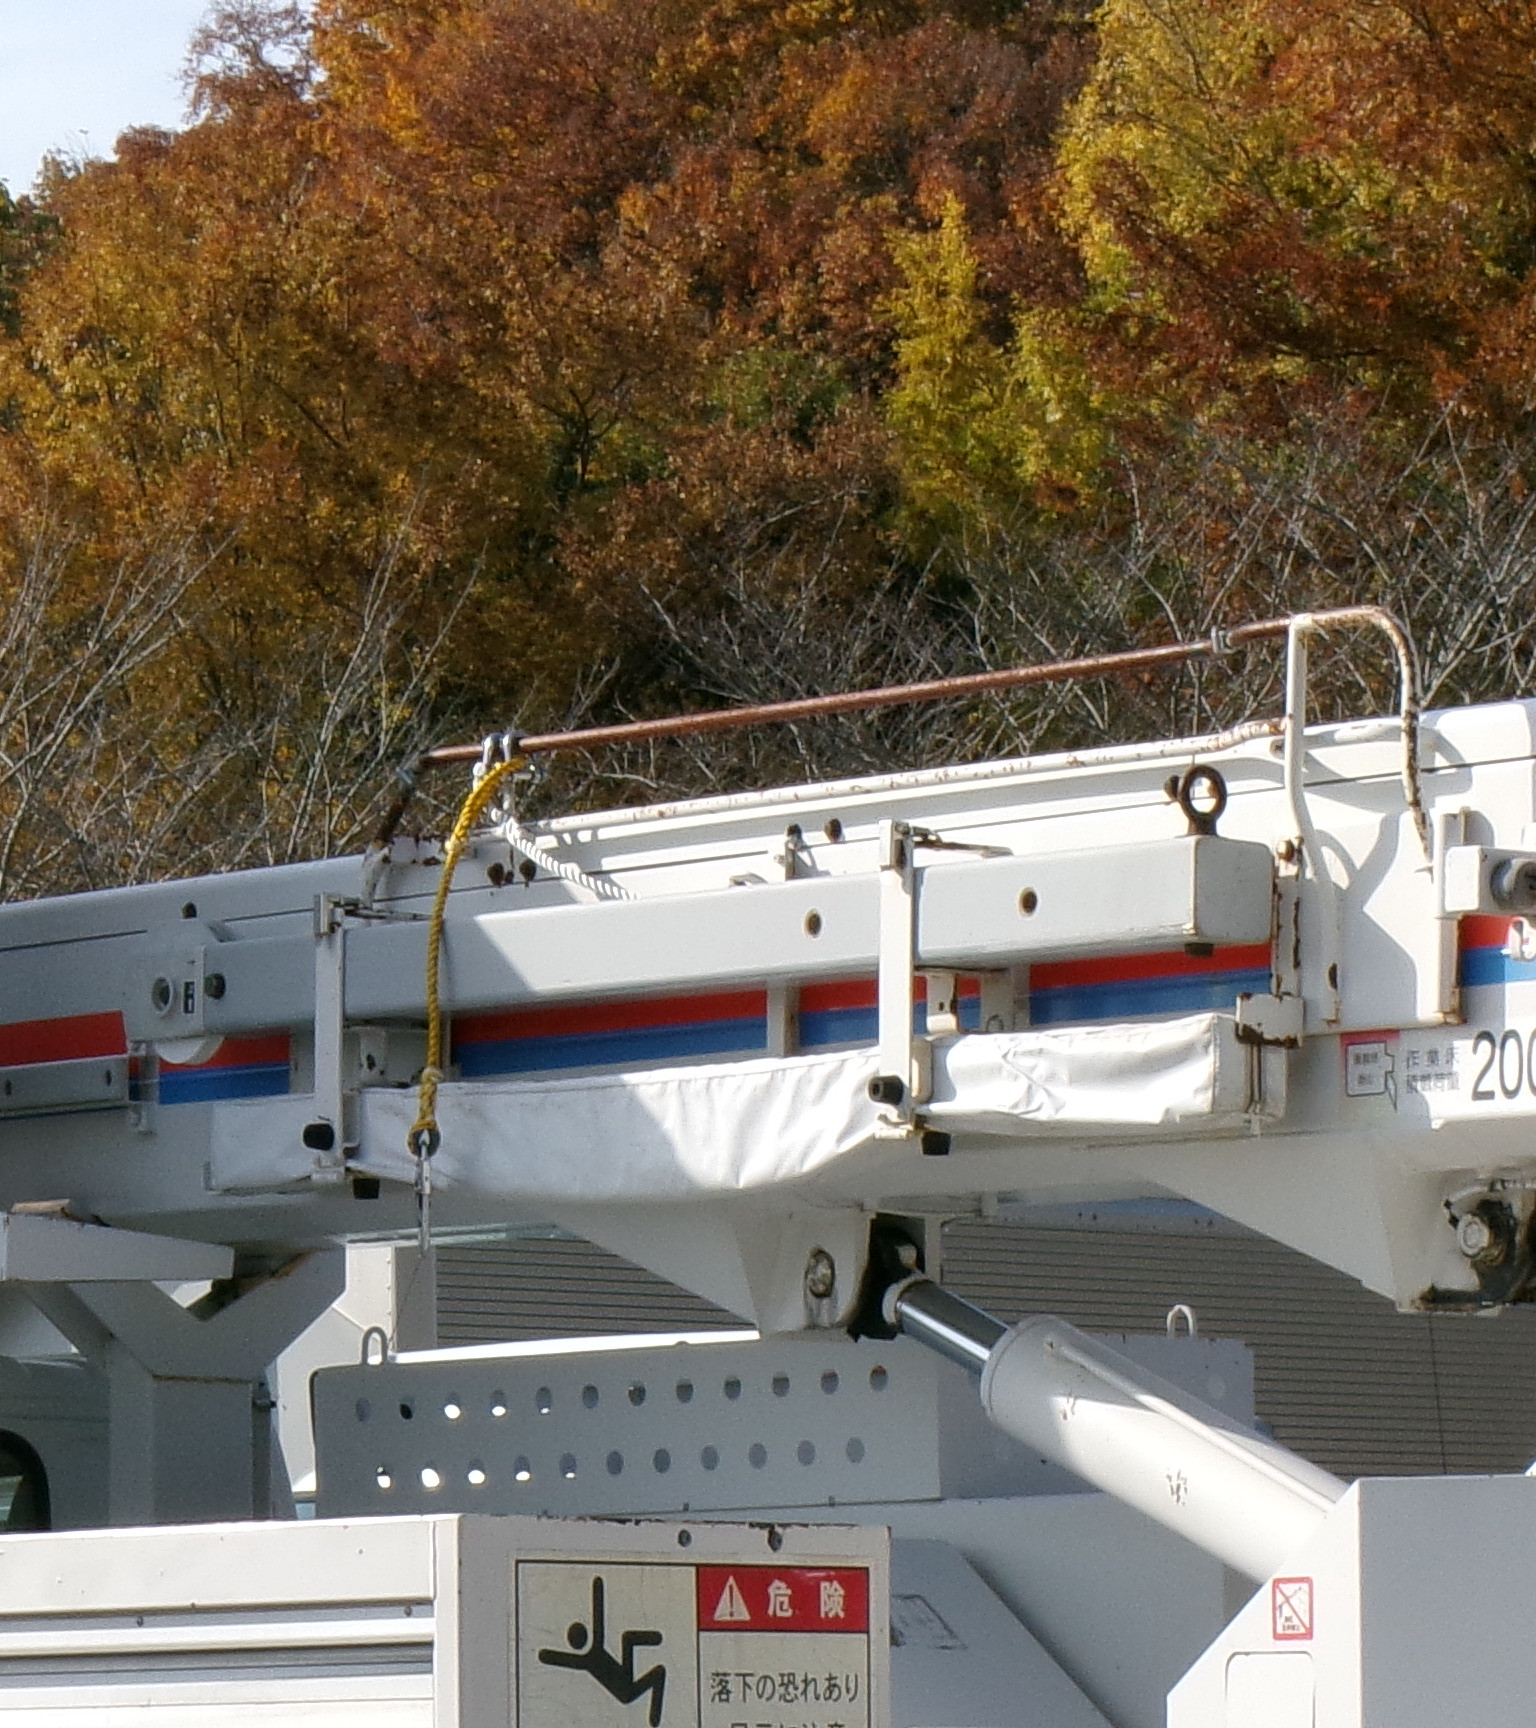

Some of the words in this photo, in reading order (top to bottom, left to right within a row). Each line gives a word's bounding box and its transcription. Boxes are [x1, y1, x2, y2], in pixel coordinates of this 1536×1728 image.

[766, 1578, 846, 1619] 危険
[710, 1671, 860, 1704] 落下の恐れあり
